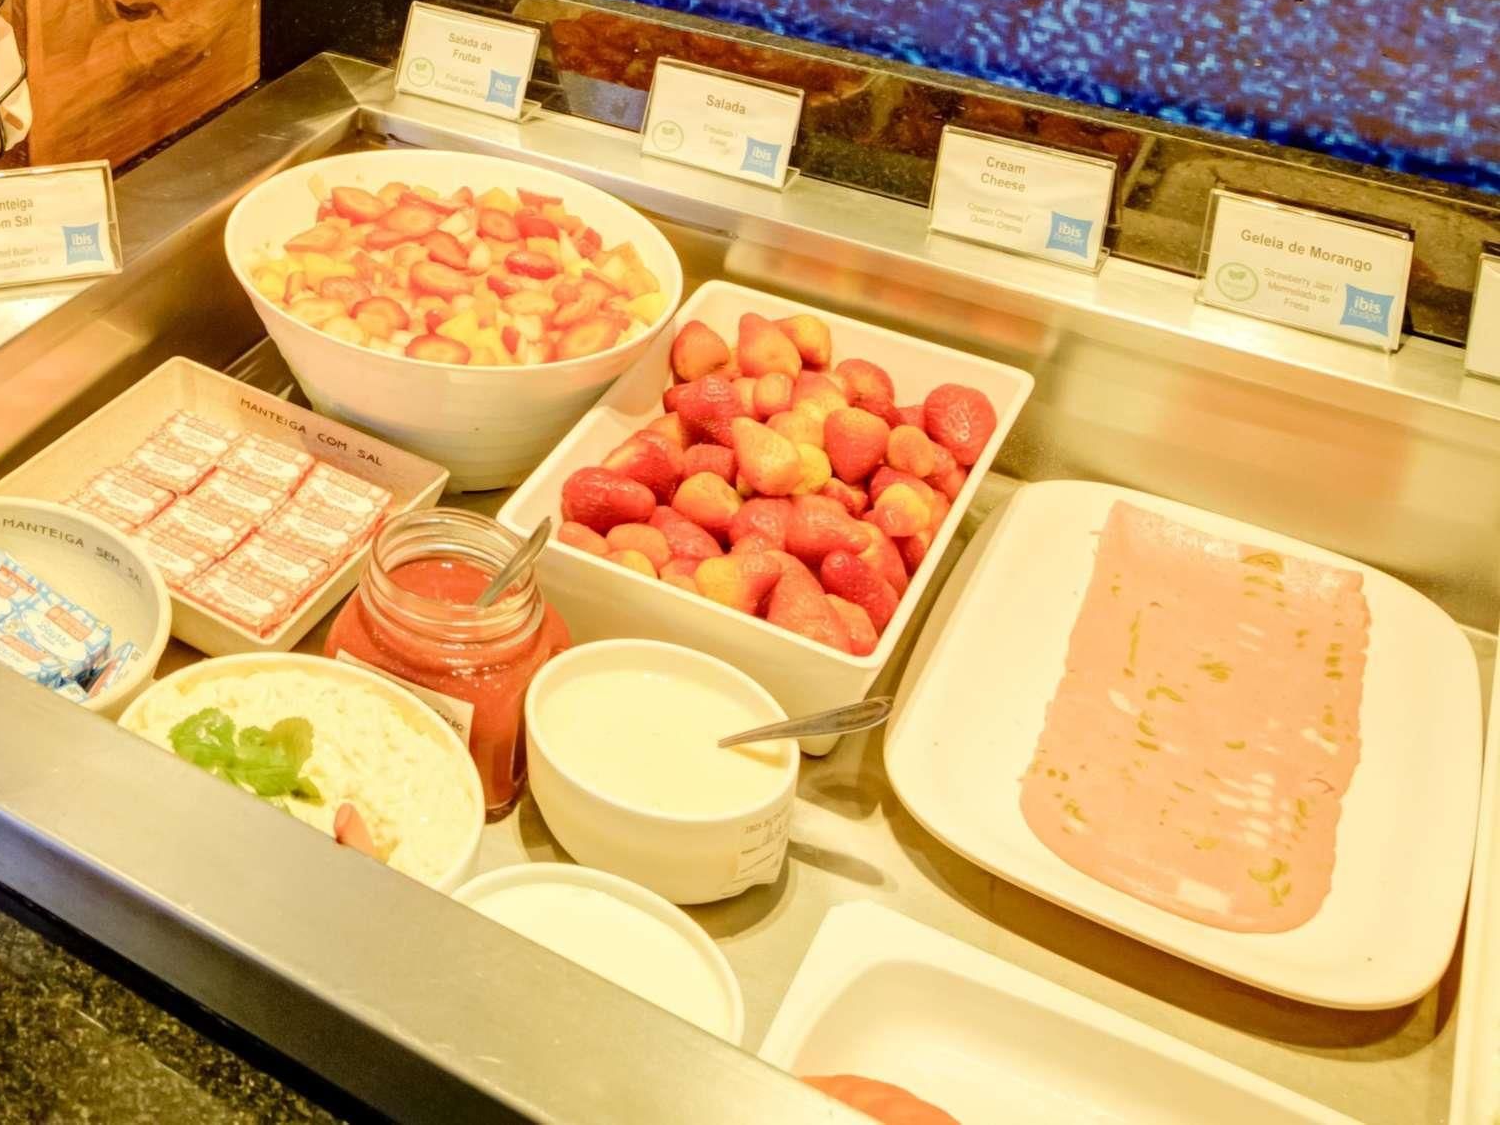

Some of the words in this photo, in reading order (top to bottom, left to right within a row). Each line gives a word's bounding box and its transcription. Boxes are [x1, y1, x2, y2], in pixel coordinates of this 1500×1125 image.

[448, 33, 479, 49] Salada
[480, 41, 493, 52] de
[452, 49, 482, 64] Frutas
[706, 94, 746, 115] Salada
[986, 156, 1026, 175] Cream
[981, 172, 1026, 193] Cheese
[14, 215, 33, 228] Sal
[1058, 221, 1082, 238] ibis
[71, 233, 93, 246] ibis
[1241, 229, 1285, 250] Geleia
[1288, 241, 1306, 255] de
[1309, 246, 1373, 273] Morango
[1354, 295, 1381, 315] ibis
[240, 397, 308, 434] MANTEIGA
[317, 433, 348, 451] COM
[357, 449, 382, 466] SAL
[2, 518, 84, 548] MANTEIGA
[95, 546, 120, 568] SEM
